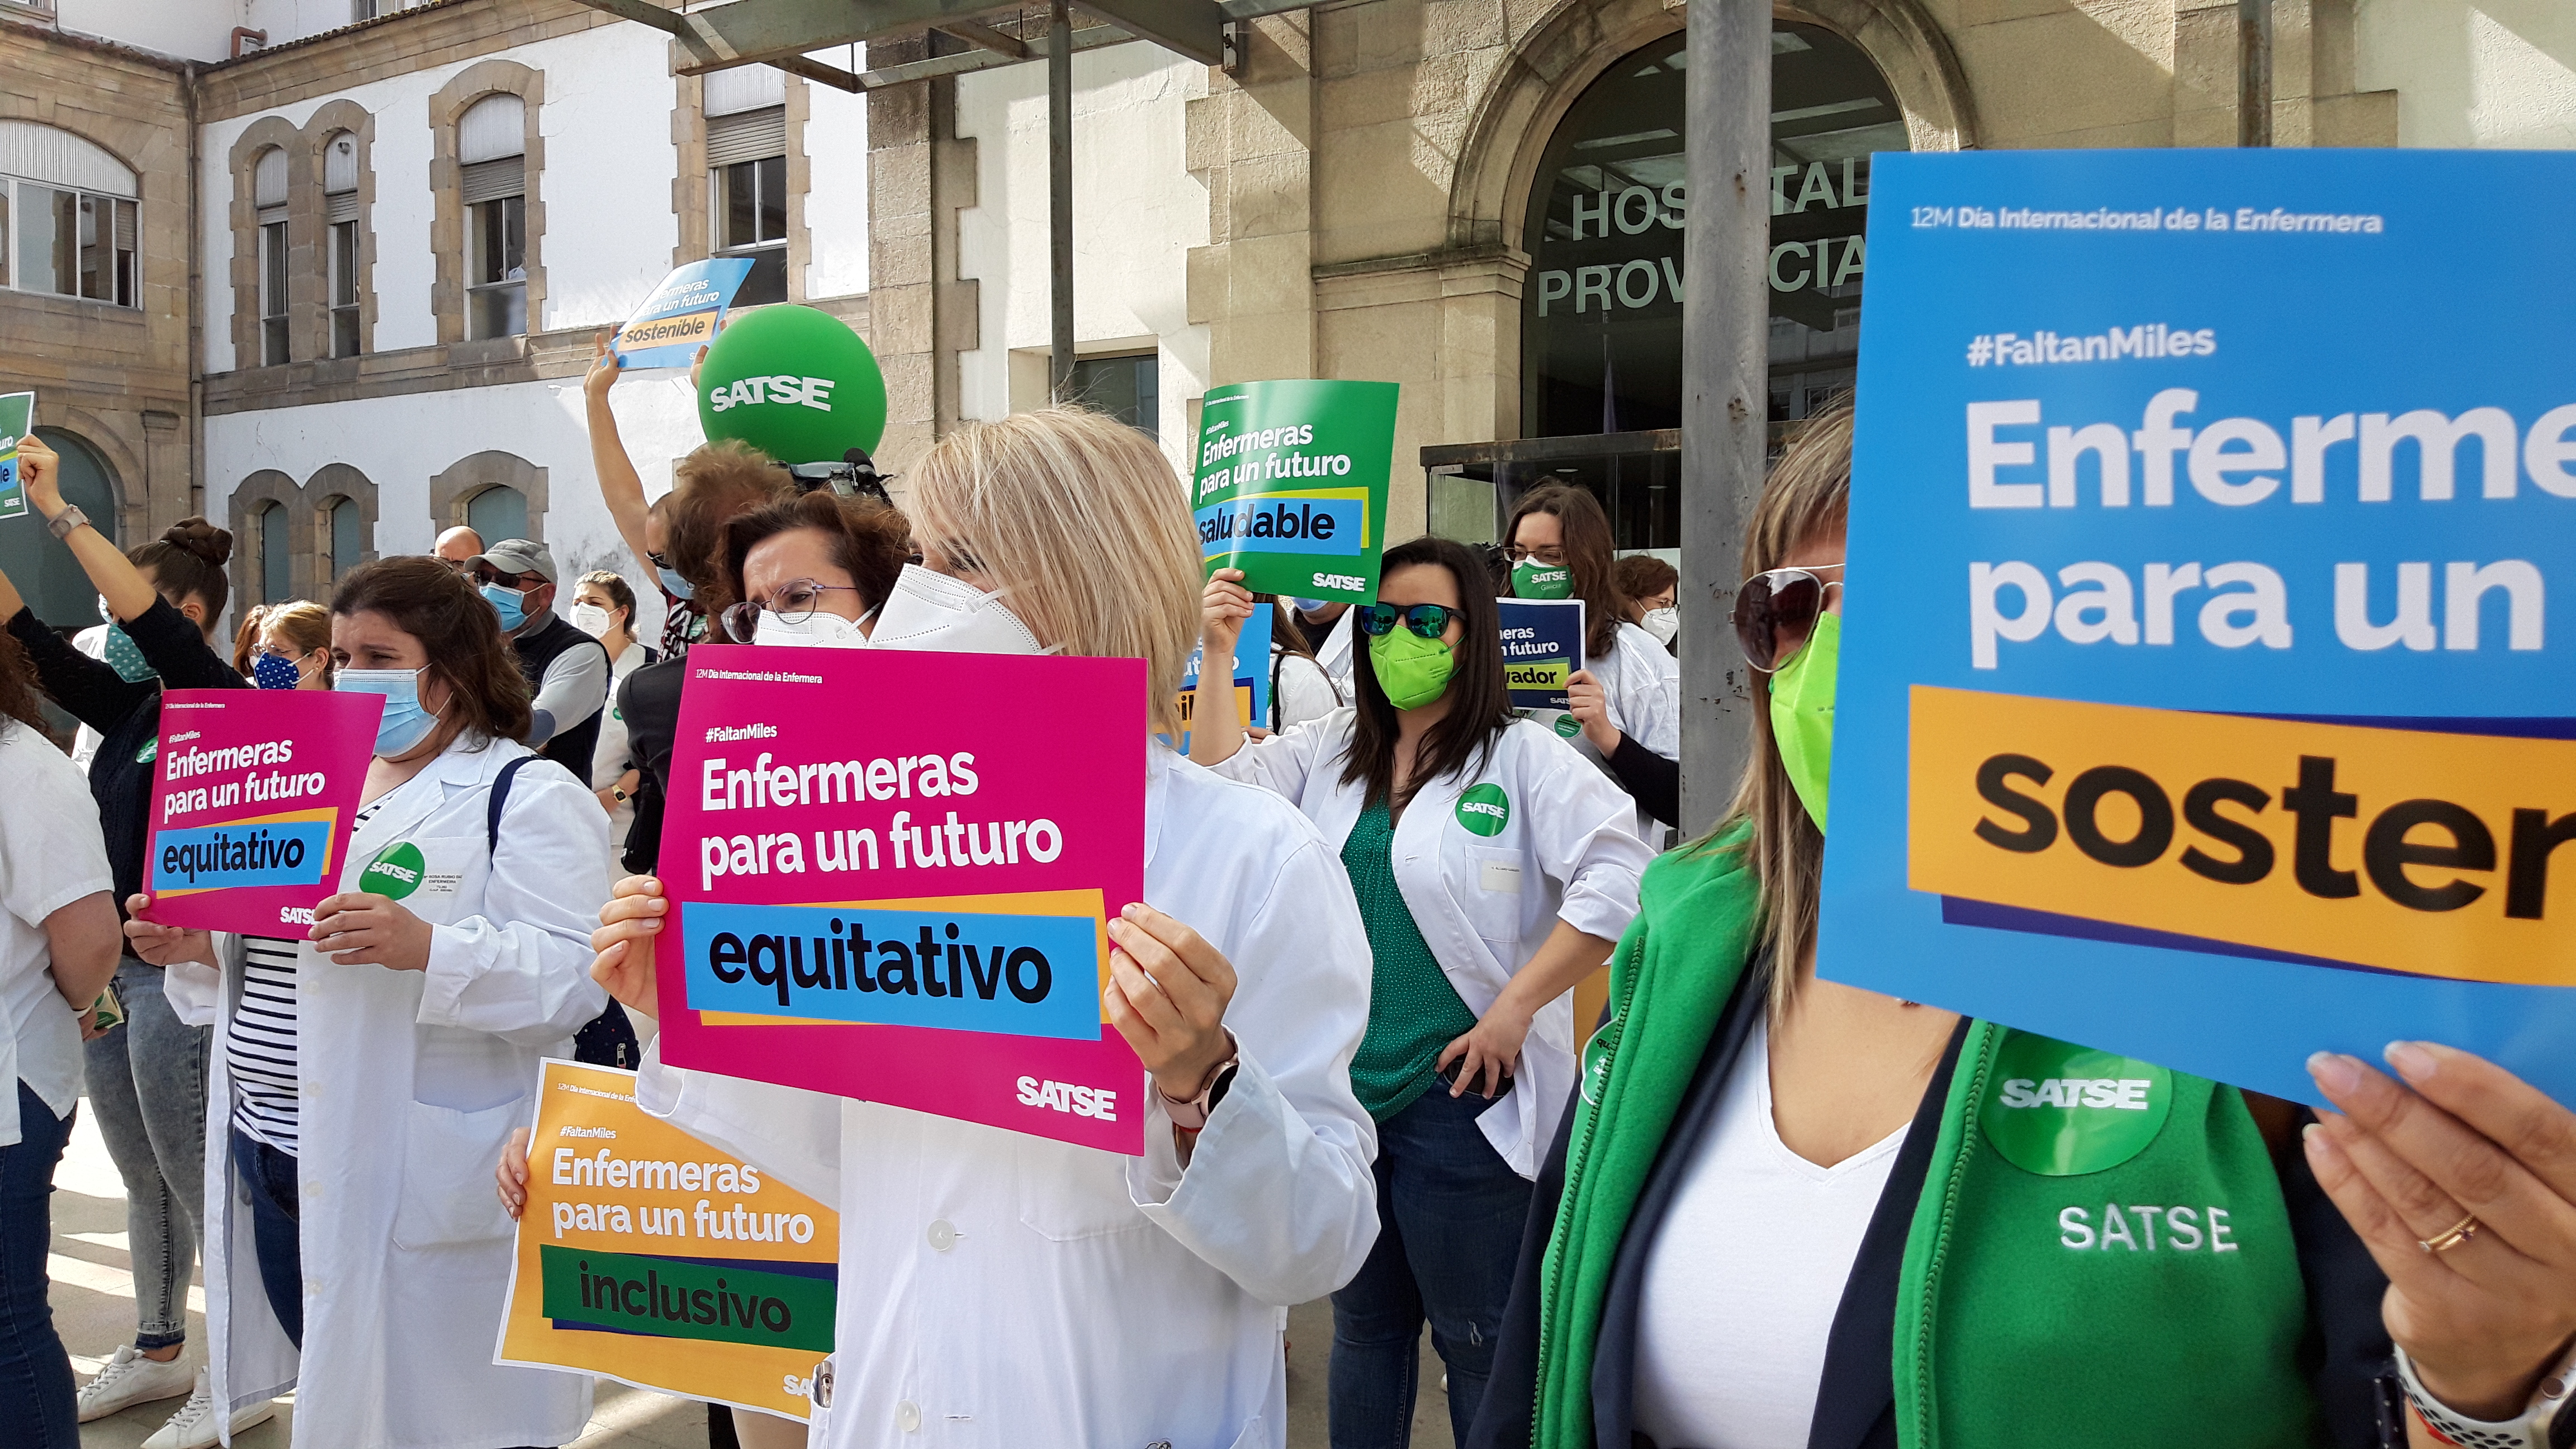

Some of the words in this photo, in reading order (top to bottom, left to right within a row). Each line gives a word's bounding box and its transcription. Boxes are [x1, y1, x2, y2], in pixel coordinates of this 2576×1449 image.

[1572, 158, 1869, 241] HOSTAL
[1910, 206, 1954, 228] 12M
[1999, 206, 2161, 230] Internacional
[2164, 207, 2200, 230] de
[2205, 207, 2228, 231] la
[2234, 208, 2384, 234] Enfermera
[1538, 234, 1866, 318] PROVCIA
[643, 305, 661, 316] ara
[664, 300, 680, 312] un
[680, 291, 720, 307] futuro
[625, 317, 705, 343] sostenible
[1966, 323, 2217, 366] #FaltanMiles
[711, 375, 836, 413] SATSE
[1202, 423, 1313, 467] Enfermeras
[1966, 387, 2576, 508] Enferme
[1199, 468, 1230, 504] para
[1233, 461, 1260, 485] un
[1265, 451, 1351, 479] futuro
[1198, 503, 1336, 546] saludable
[1312, 572, 1366, 592] SATSE
[1531, 571, 1567, 584] SATSE
[1968, 559, 2293, 669] para
[2333, 558, 2546, 651] un
[1509, 641, 1560, 656] futuro
[695, 669, 708, 678] 12M
[719, 669, 763, 681] Internacional
[764, 671, 773, 681] de
[775, 671, 782, 681] la
[783, 673, 822, 684] Enfermera
[705, 723, 778, 743] #FaltanMiles
[167, 739, 292, 781] Enfermeras
[701, 751, 979, 812] Enfermeras
[164, 788, 207, 824] para
[212, 782, 239, 807] un
[244, 771, 325, 799] futuro
[1461, 802, 1505, 819] SATSE
[163, 828, 305, 883] equitativo
[369, 861, 418, 884] SATSE
[701, 831, 805, 892] para
[815, 827, 879, 873] un
[890, 810, 1063, 870] futuro
[709, 917, 1053, 1007] equitativo
[1016, 1075, 1117, 1123] SATSE
[1999, 1077, 2151, 1110] SATSE
[560, 1125, 616, 1139] #FaltanMiles
[552, 1147, 761, 1194] Enfermeras
[552, 1199, 632, 1239] para
[640, 1205, 685, 1237] un
[693, 1199, 815, 1244] futuro
[2058, 1202, 2238, 1252] SATSE
[579, 1259, 792, 1333] inclusivo
